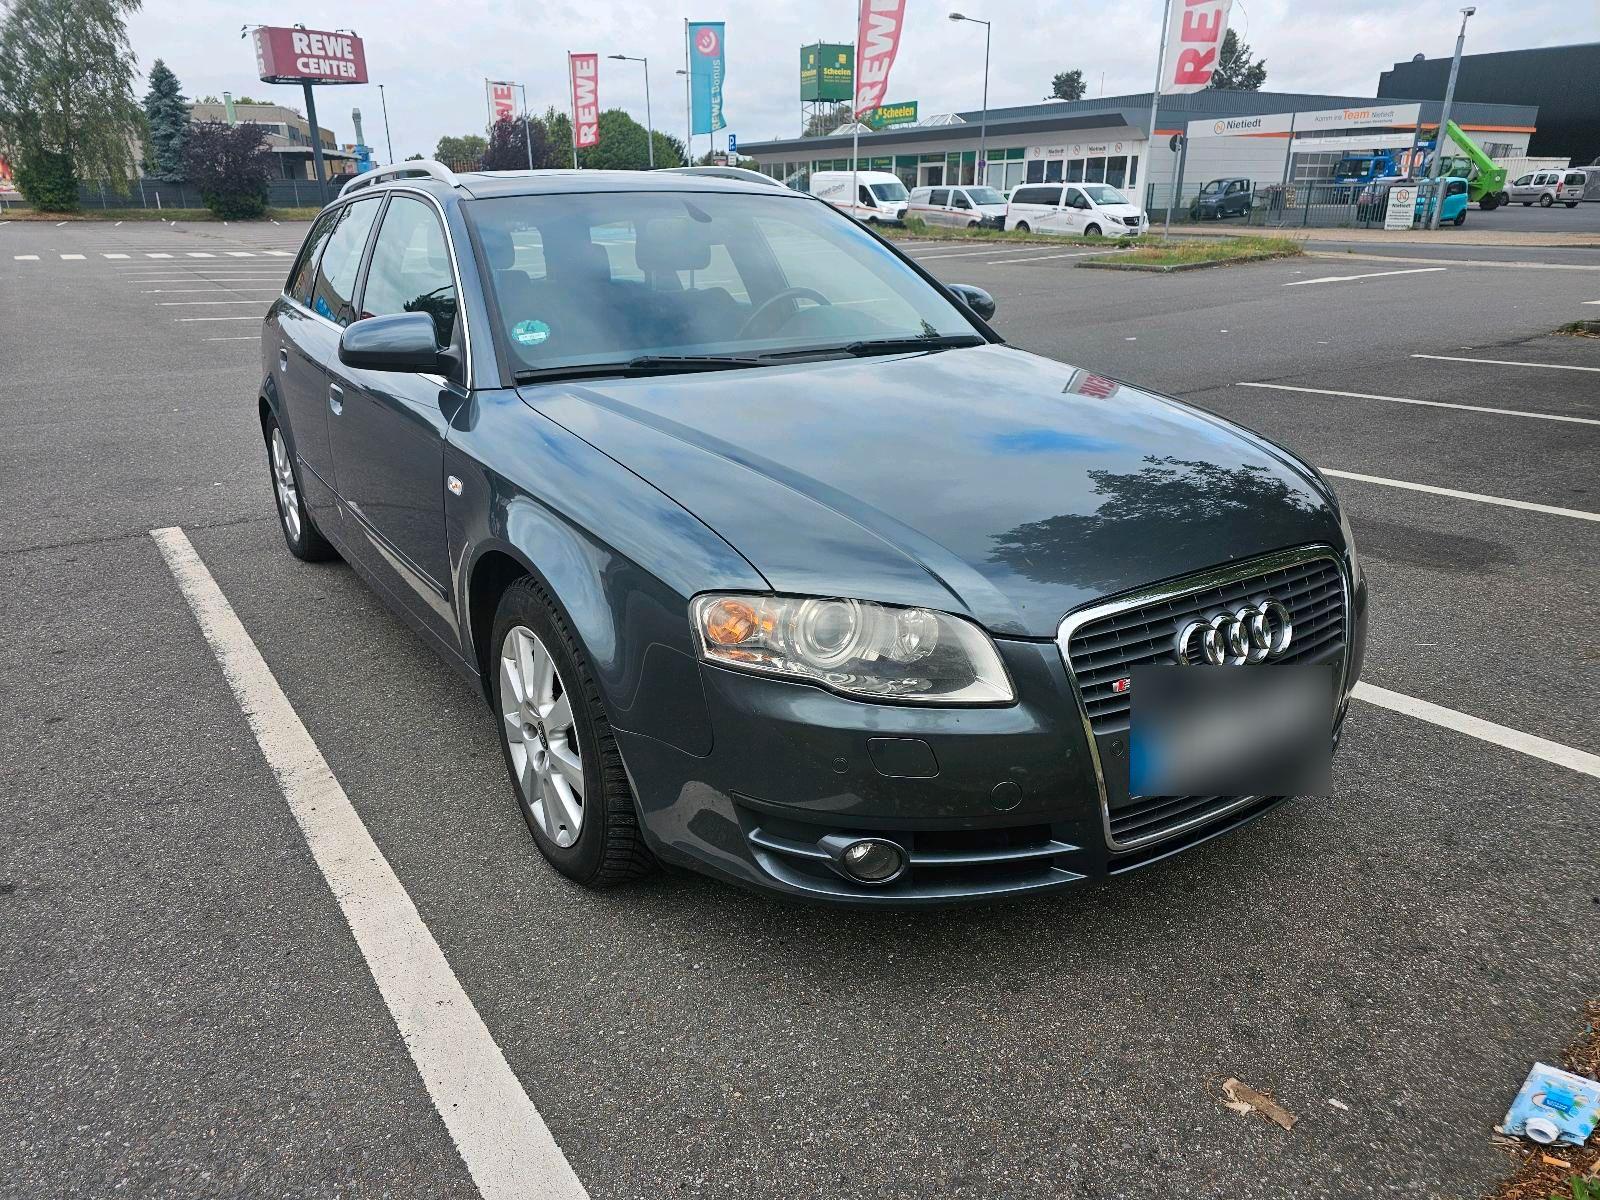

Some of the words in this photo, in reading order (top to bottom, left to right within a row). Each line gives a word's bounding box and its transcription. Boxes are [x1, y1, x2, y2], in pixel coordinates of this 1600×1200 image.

[292, 32, 354, 60] REWE
[1174, 0, 1222, 84] RE
[296, 57, 357, 78] CENTER
[711, 59, 721, 93] Bonus
[823, 67, 851, 76] Scheelen
[493, 86, 514, 123] WE
[575, 59, 598, 144] REWE
[711, 94, 721, 130] REWE
[882, 105, 914, 119] Scheelen
[1343, 109, 1370, 120] Team
[1226, 118, 1262, 130] Nietiedt
